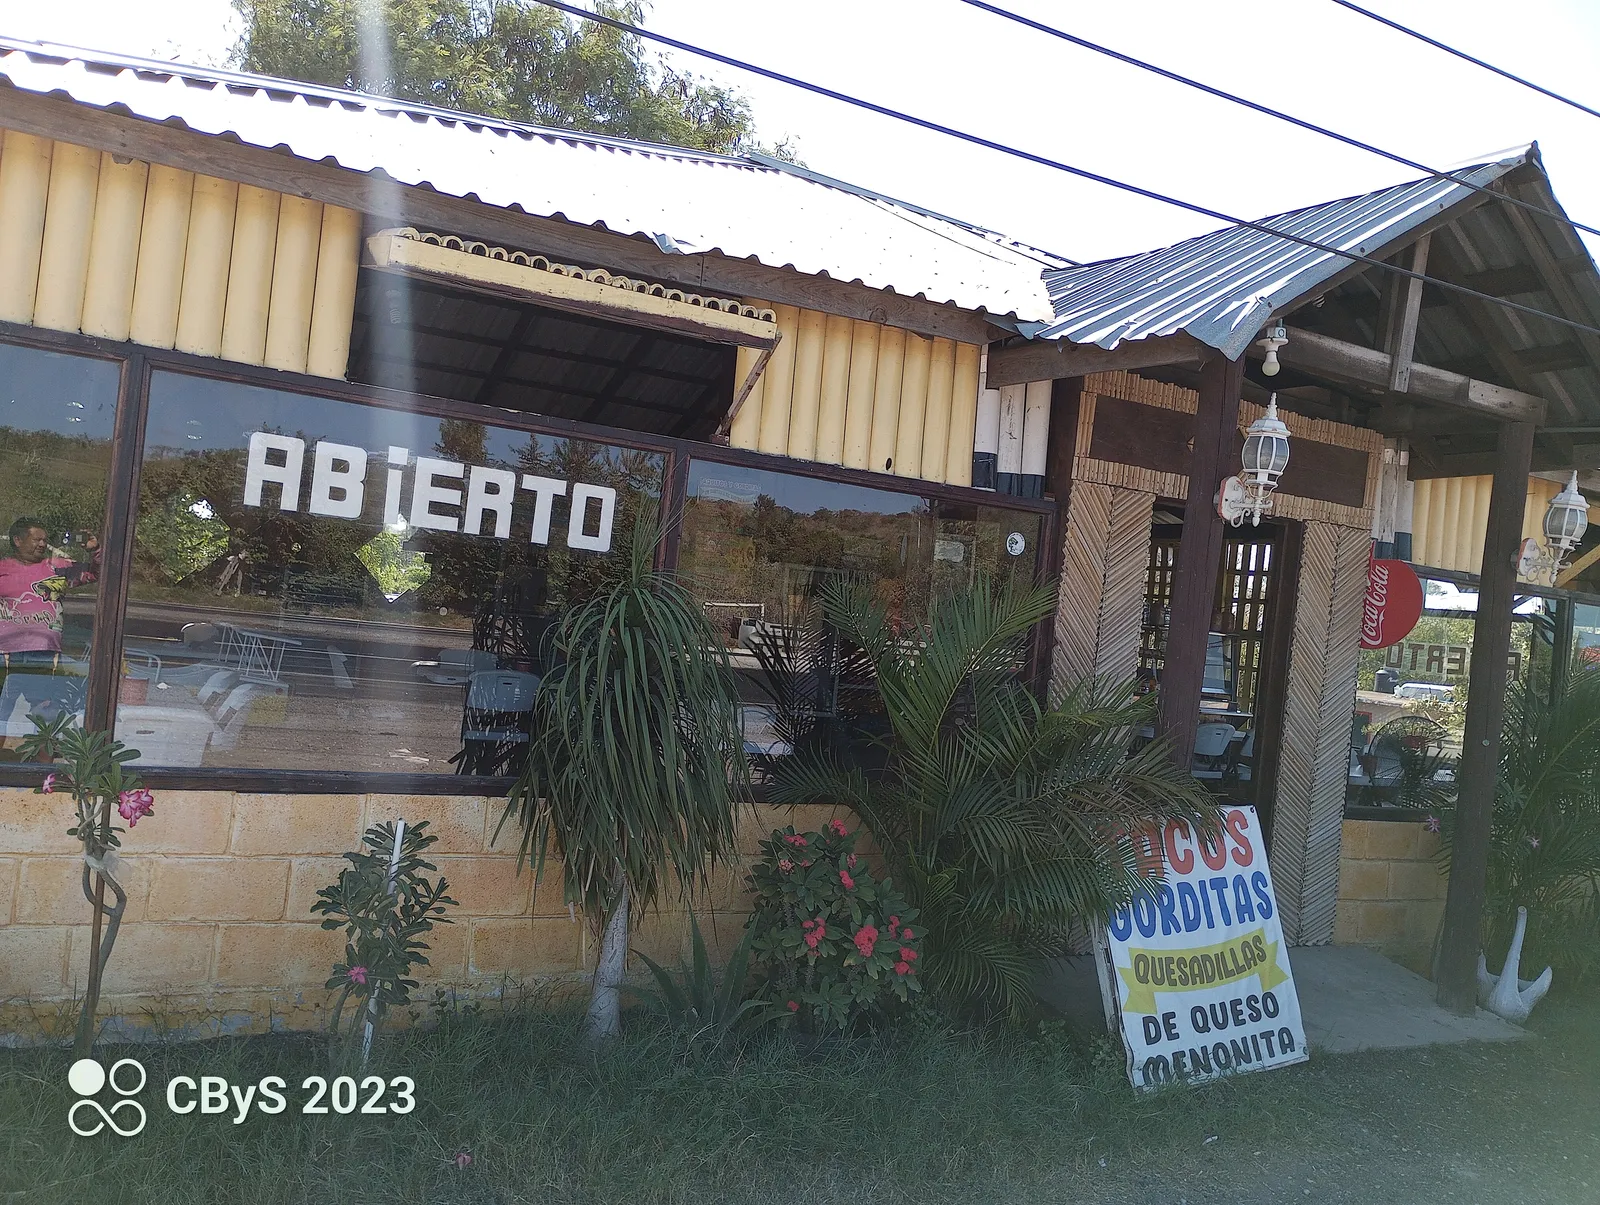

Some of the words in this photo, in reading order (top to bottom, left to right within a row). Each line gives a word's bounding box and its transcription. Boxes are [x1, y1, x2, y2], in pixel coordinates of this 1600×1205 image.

[1134, 935, 1267, 986] QUESADILLAS
[1142, 1011, 1180, 1046] DE
[1190, 991, 1280, 1034] QUESO
[1142, 1027, 1296, 1087] MENONITA
